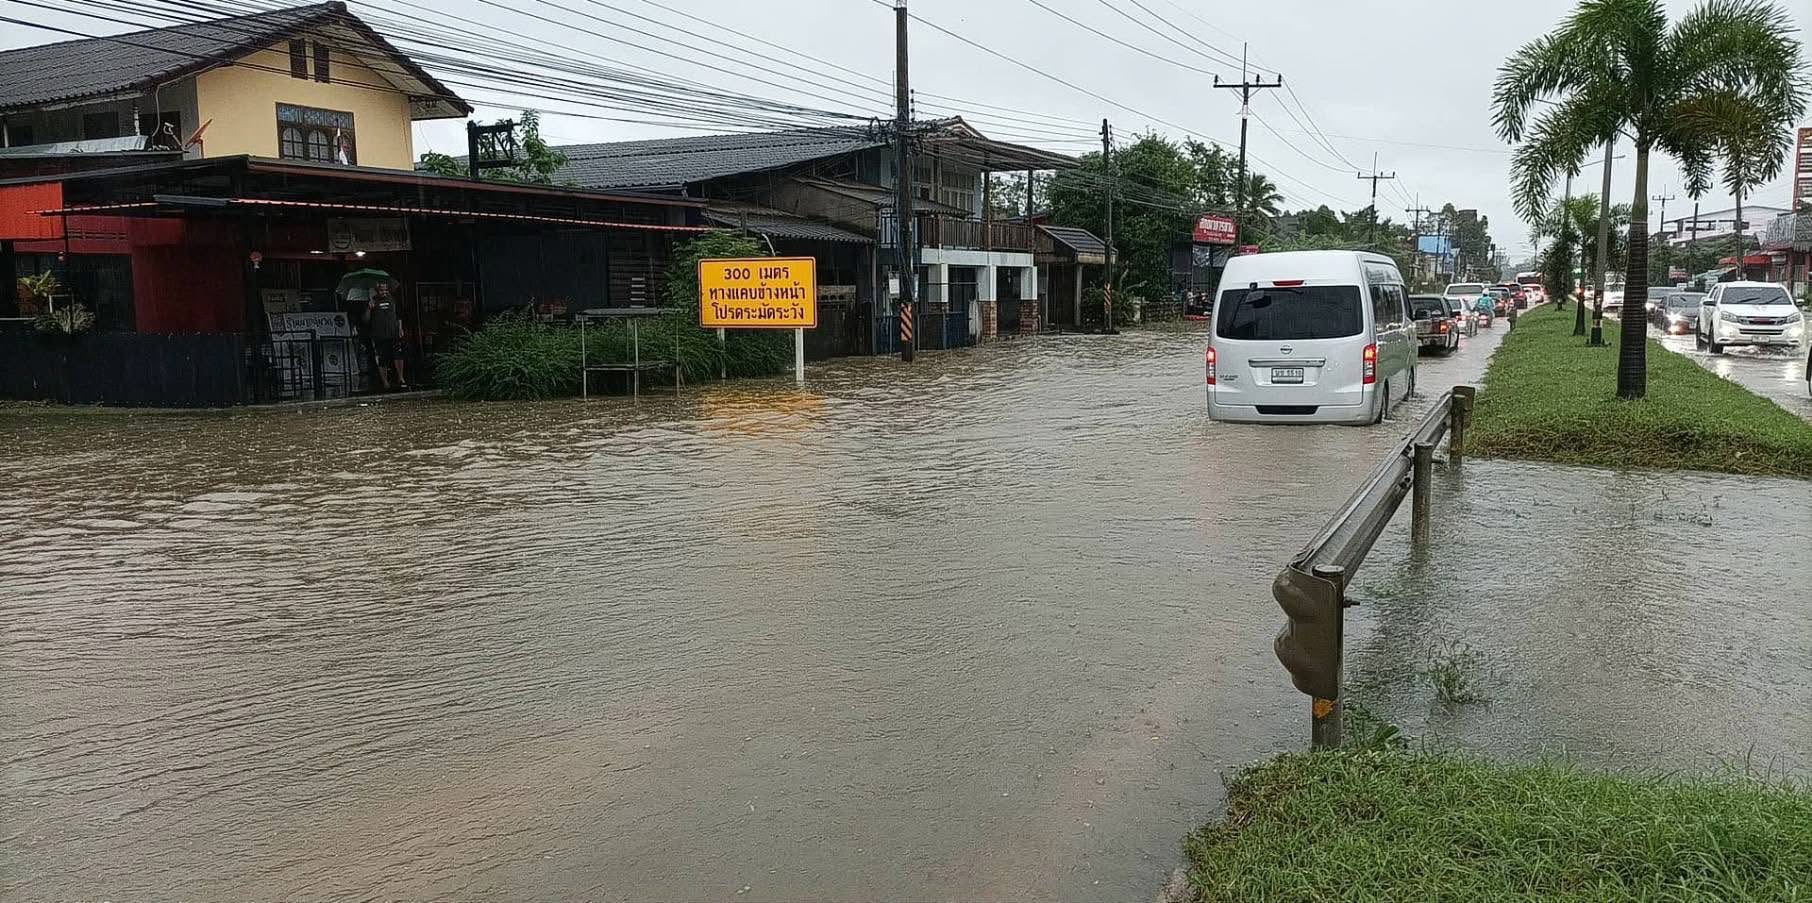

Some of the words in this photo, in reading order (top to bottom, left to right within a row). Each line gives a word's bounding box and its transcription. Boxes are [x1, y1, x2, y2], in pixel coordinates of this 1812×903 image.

[724, 268, 751, 280] 300
[759, 267, 790, 279] เมตร
[709, 282, 806, 300] ทางแคบข้างหน้า
[711, 302, 804, 320] โปรดระมัดระวัง
